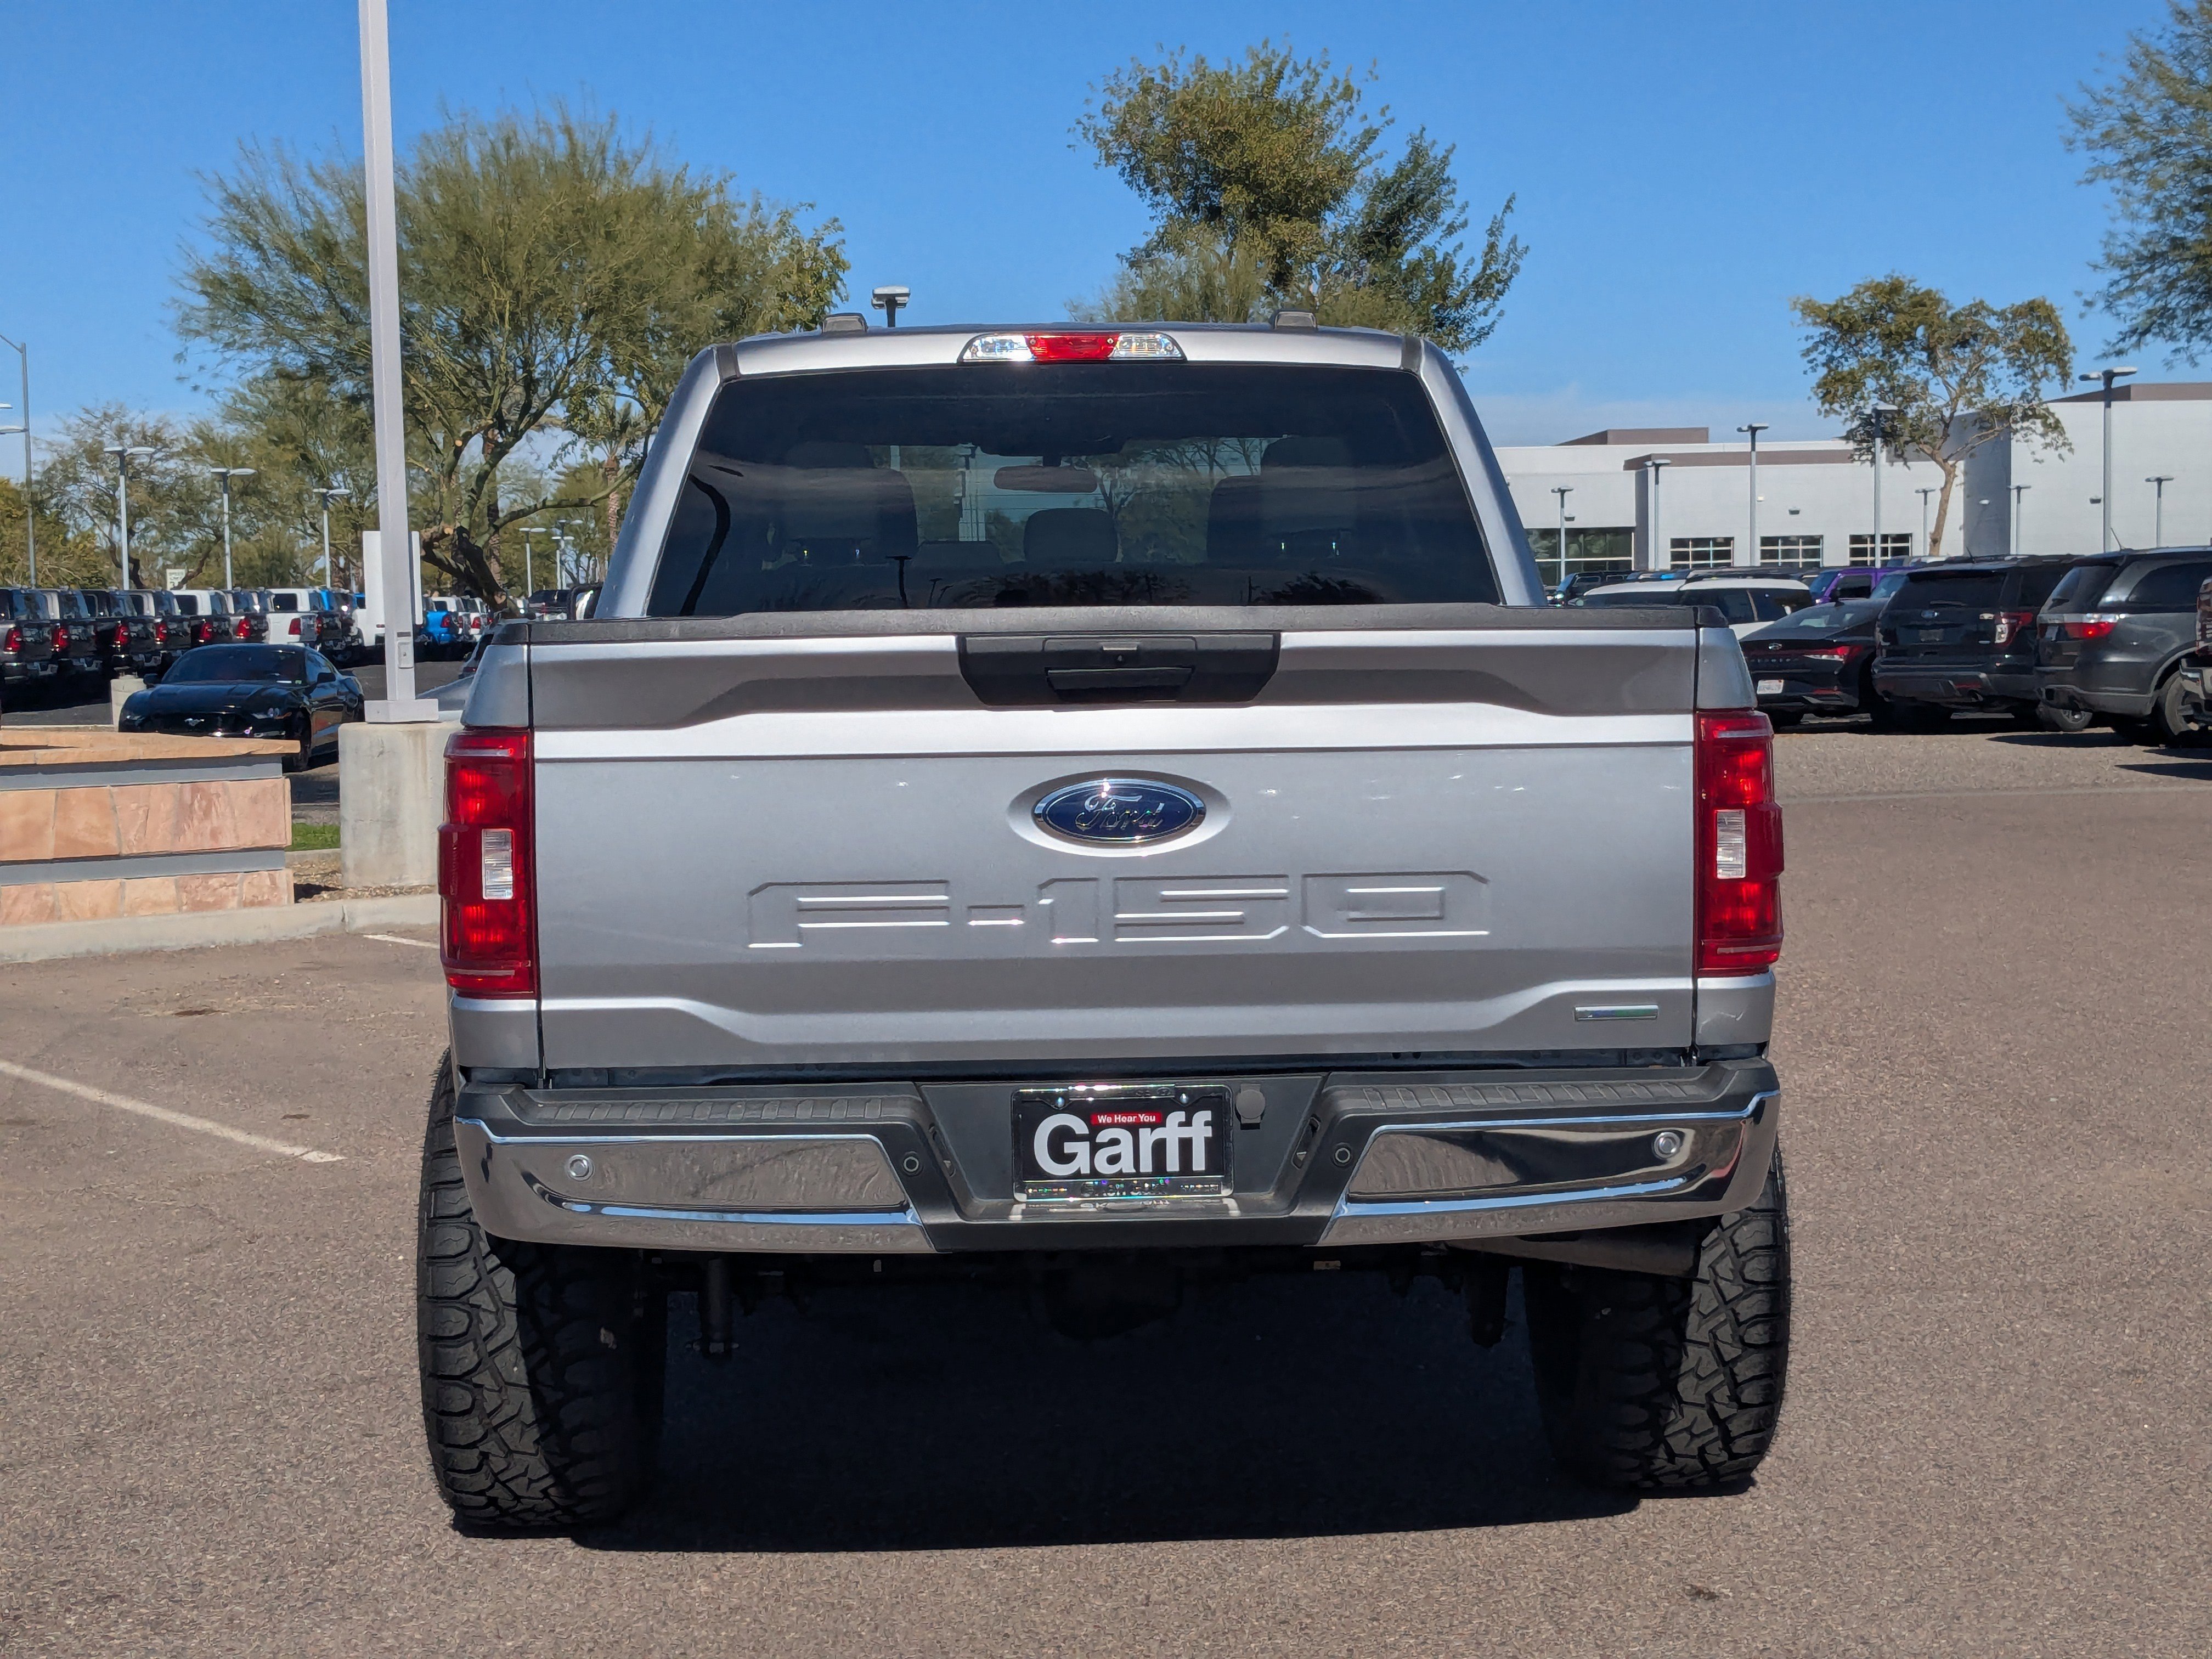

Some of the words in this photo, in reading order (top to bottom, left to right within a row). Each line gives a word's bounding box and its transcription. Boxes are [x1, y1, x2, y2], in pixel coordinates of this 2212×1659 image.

[1075, 793, 1165, 831] Ford
[747, 871, 1491, 948] F-150
[1033, 1110, 1212, 1177] Garff
[1097, 1114, 1113, 1124] We
[1114, 1114, 1138, 1124] Hear
[1138, 1113, 1156, 1123] You
